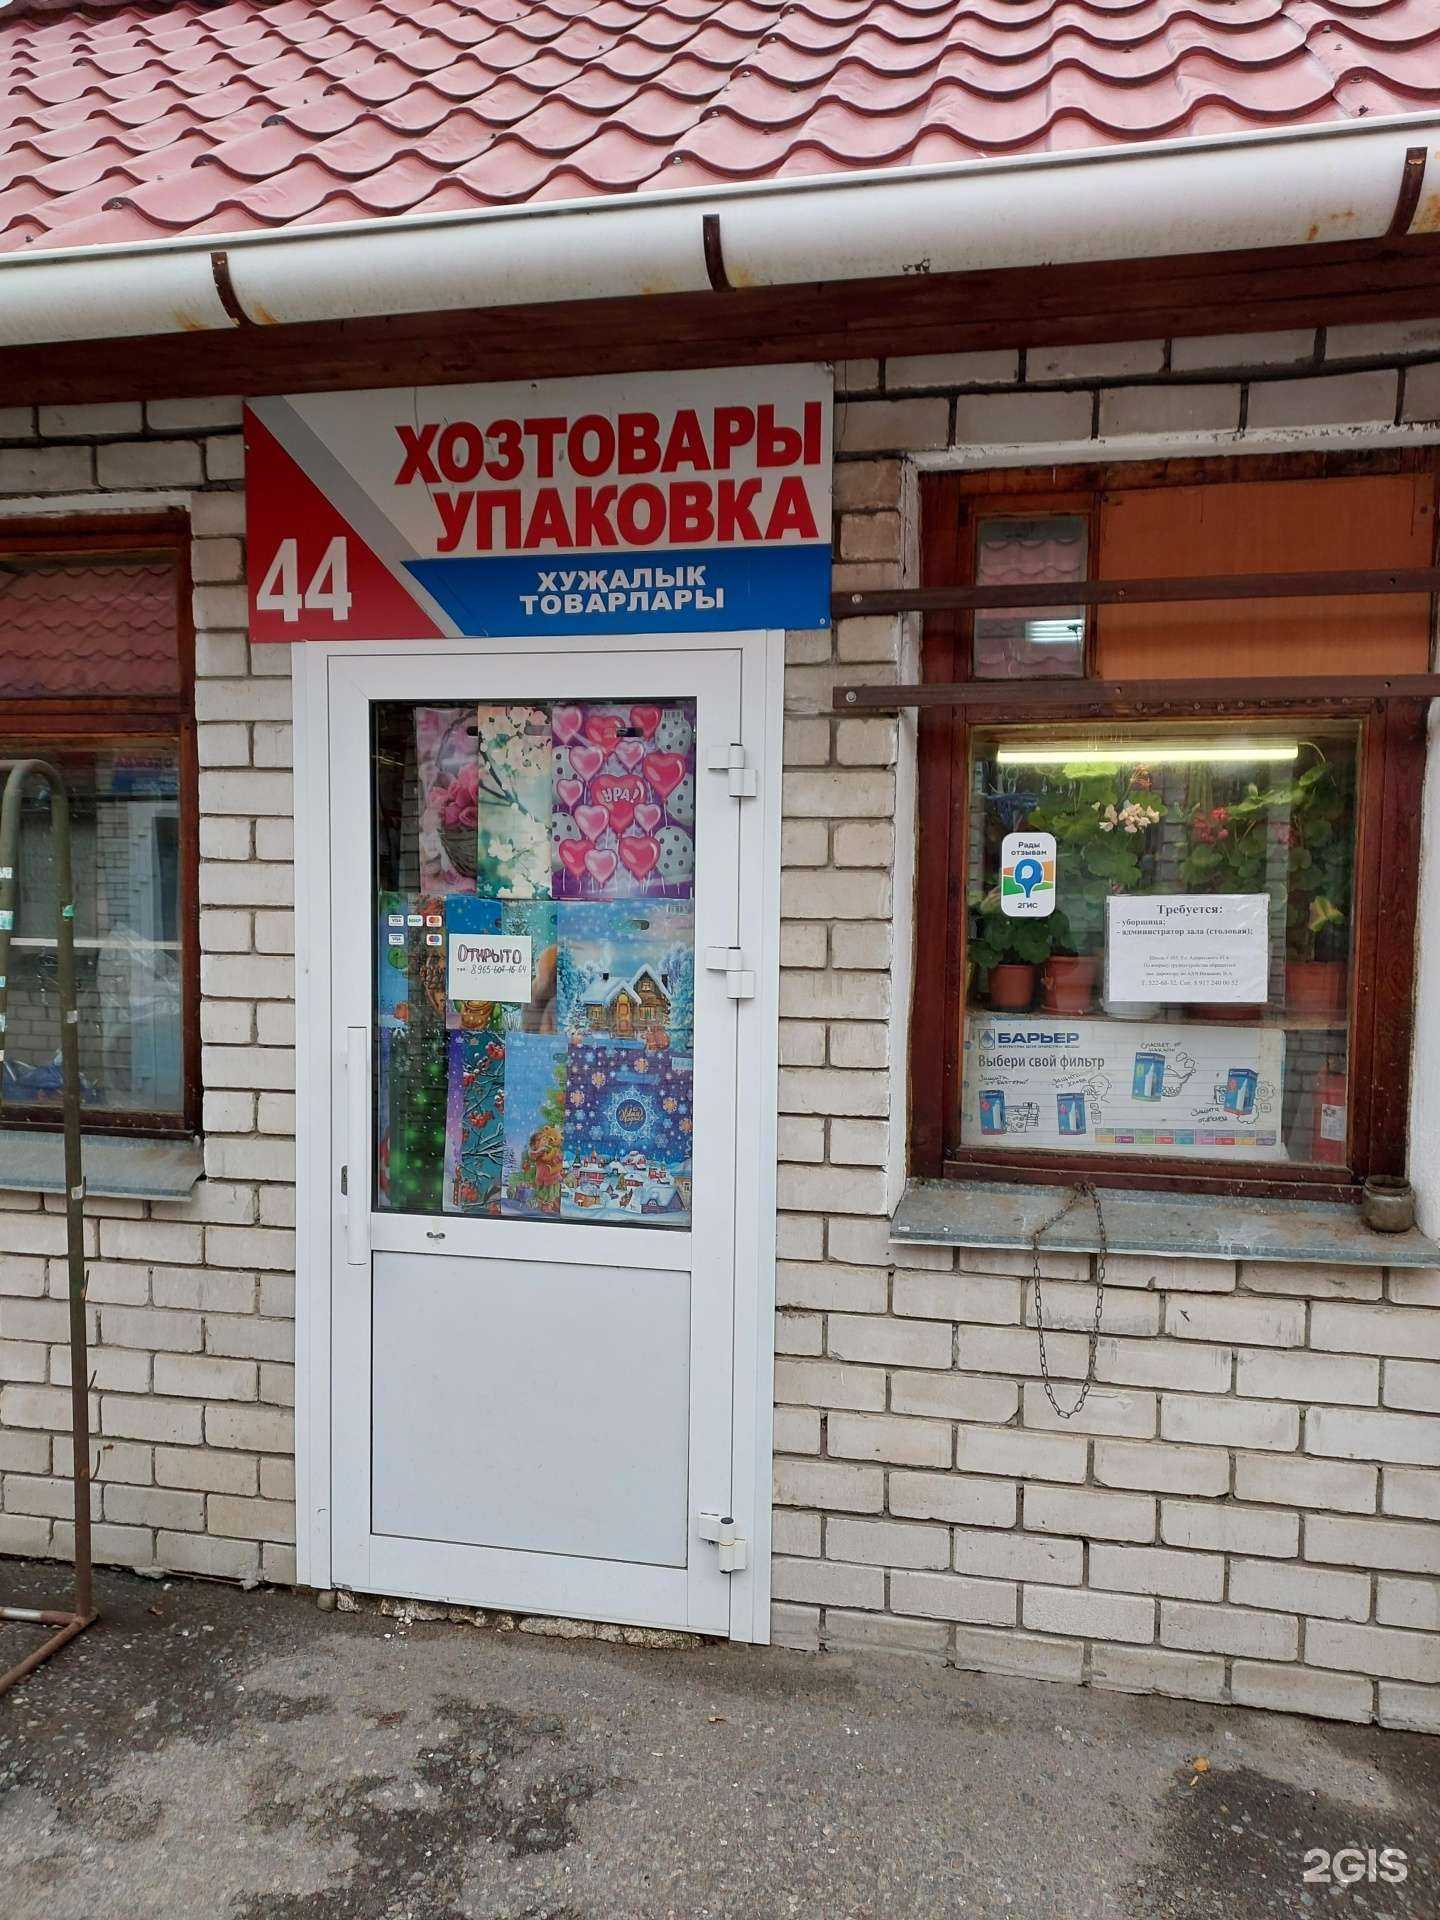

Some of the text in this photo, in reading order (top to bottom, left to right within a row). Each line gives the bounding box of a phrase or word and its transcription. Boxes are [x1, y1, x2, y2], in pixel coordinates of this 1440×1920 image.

[394, 401, 823, 485] ХОЗТОВАРЫ
[434, 475, 819, 552] УПАКОВКА
[256, 535, 353, 623] 44
[519, 588, 724, 615] ТОВАРЛАРЫ
[1018, 841, 1041, 849] Рады
[1157, 904, 1223, 917] Требуется:
[1121, 929, 1185, 937] администратор
[998, 1032, 1079, 1044] БАРЬЕР
[978, 1054, 1105, 1071] Выбери свой фильтр
